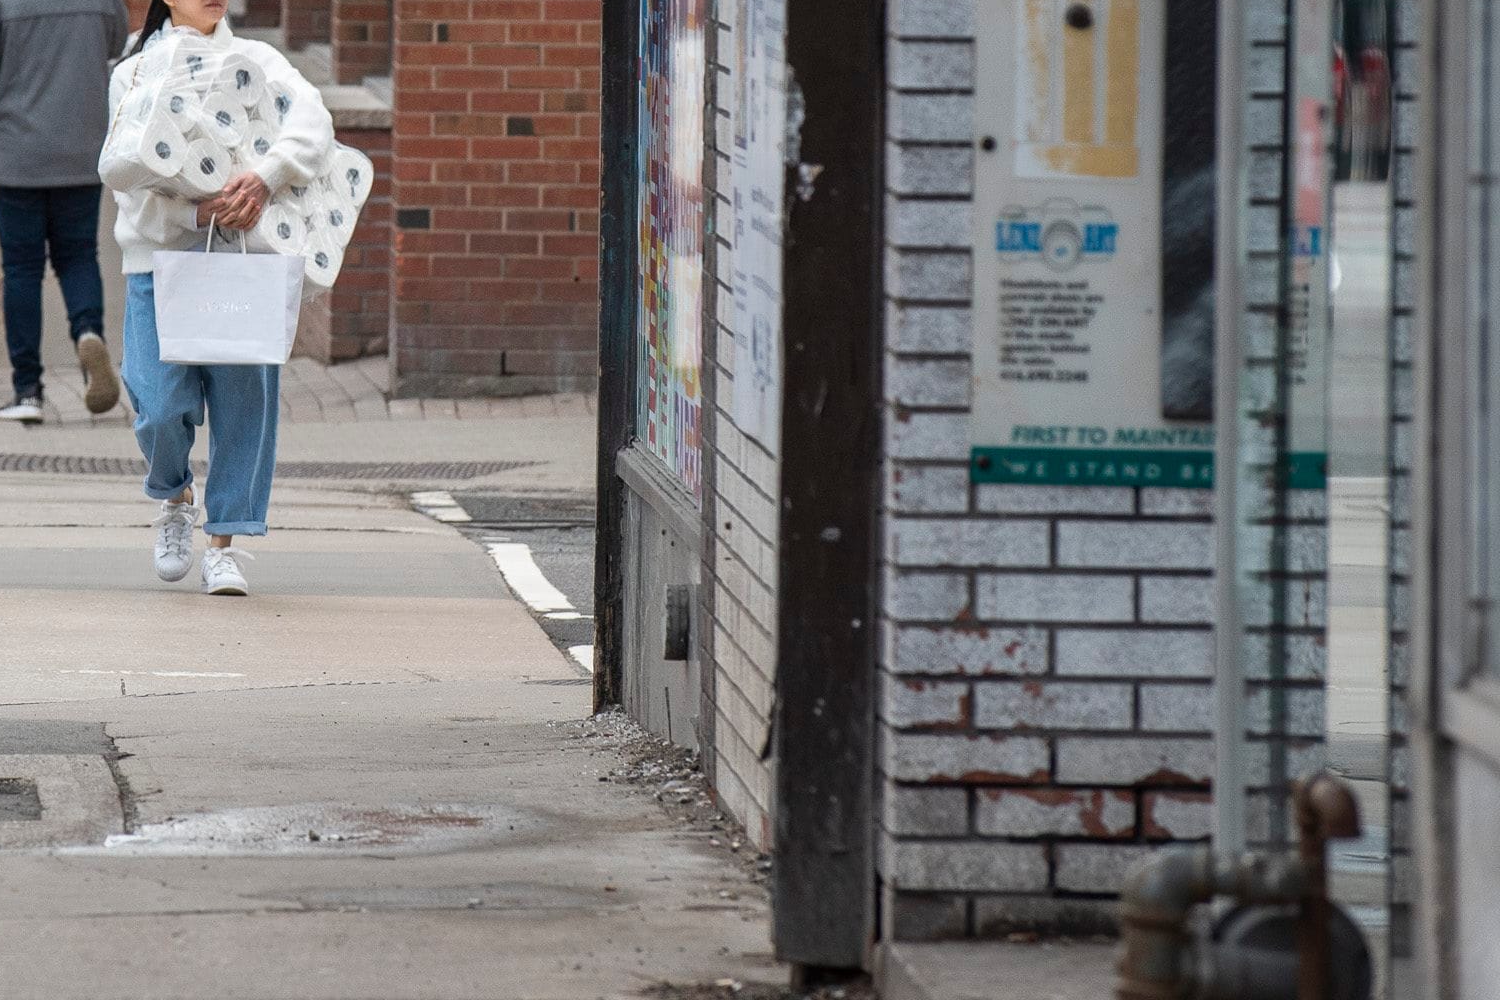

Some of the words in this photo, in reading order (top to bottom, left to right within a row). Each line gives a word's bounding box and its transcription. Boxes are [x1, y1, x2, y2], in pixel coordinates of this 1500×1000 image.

[1011, 425, 1068, 442] FIRST
[1075, 426, 1107, 443] TO
[1068, 461, 1161, 479] STAND
